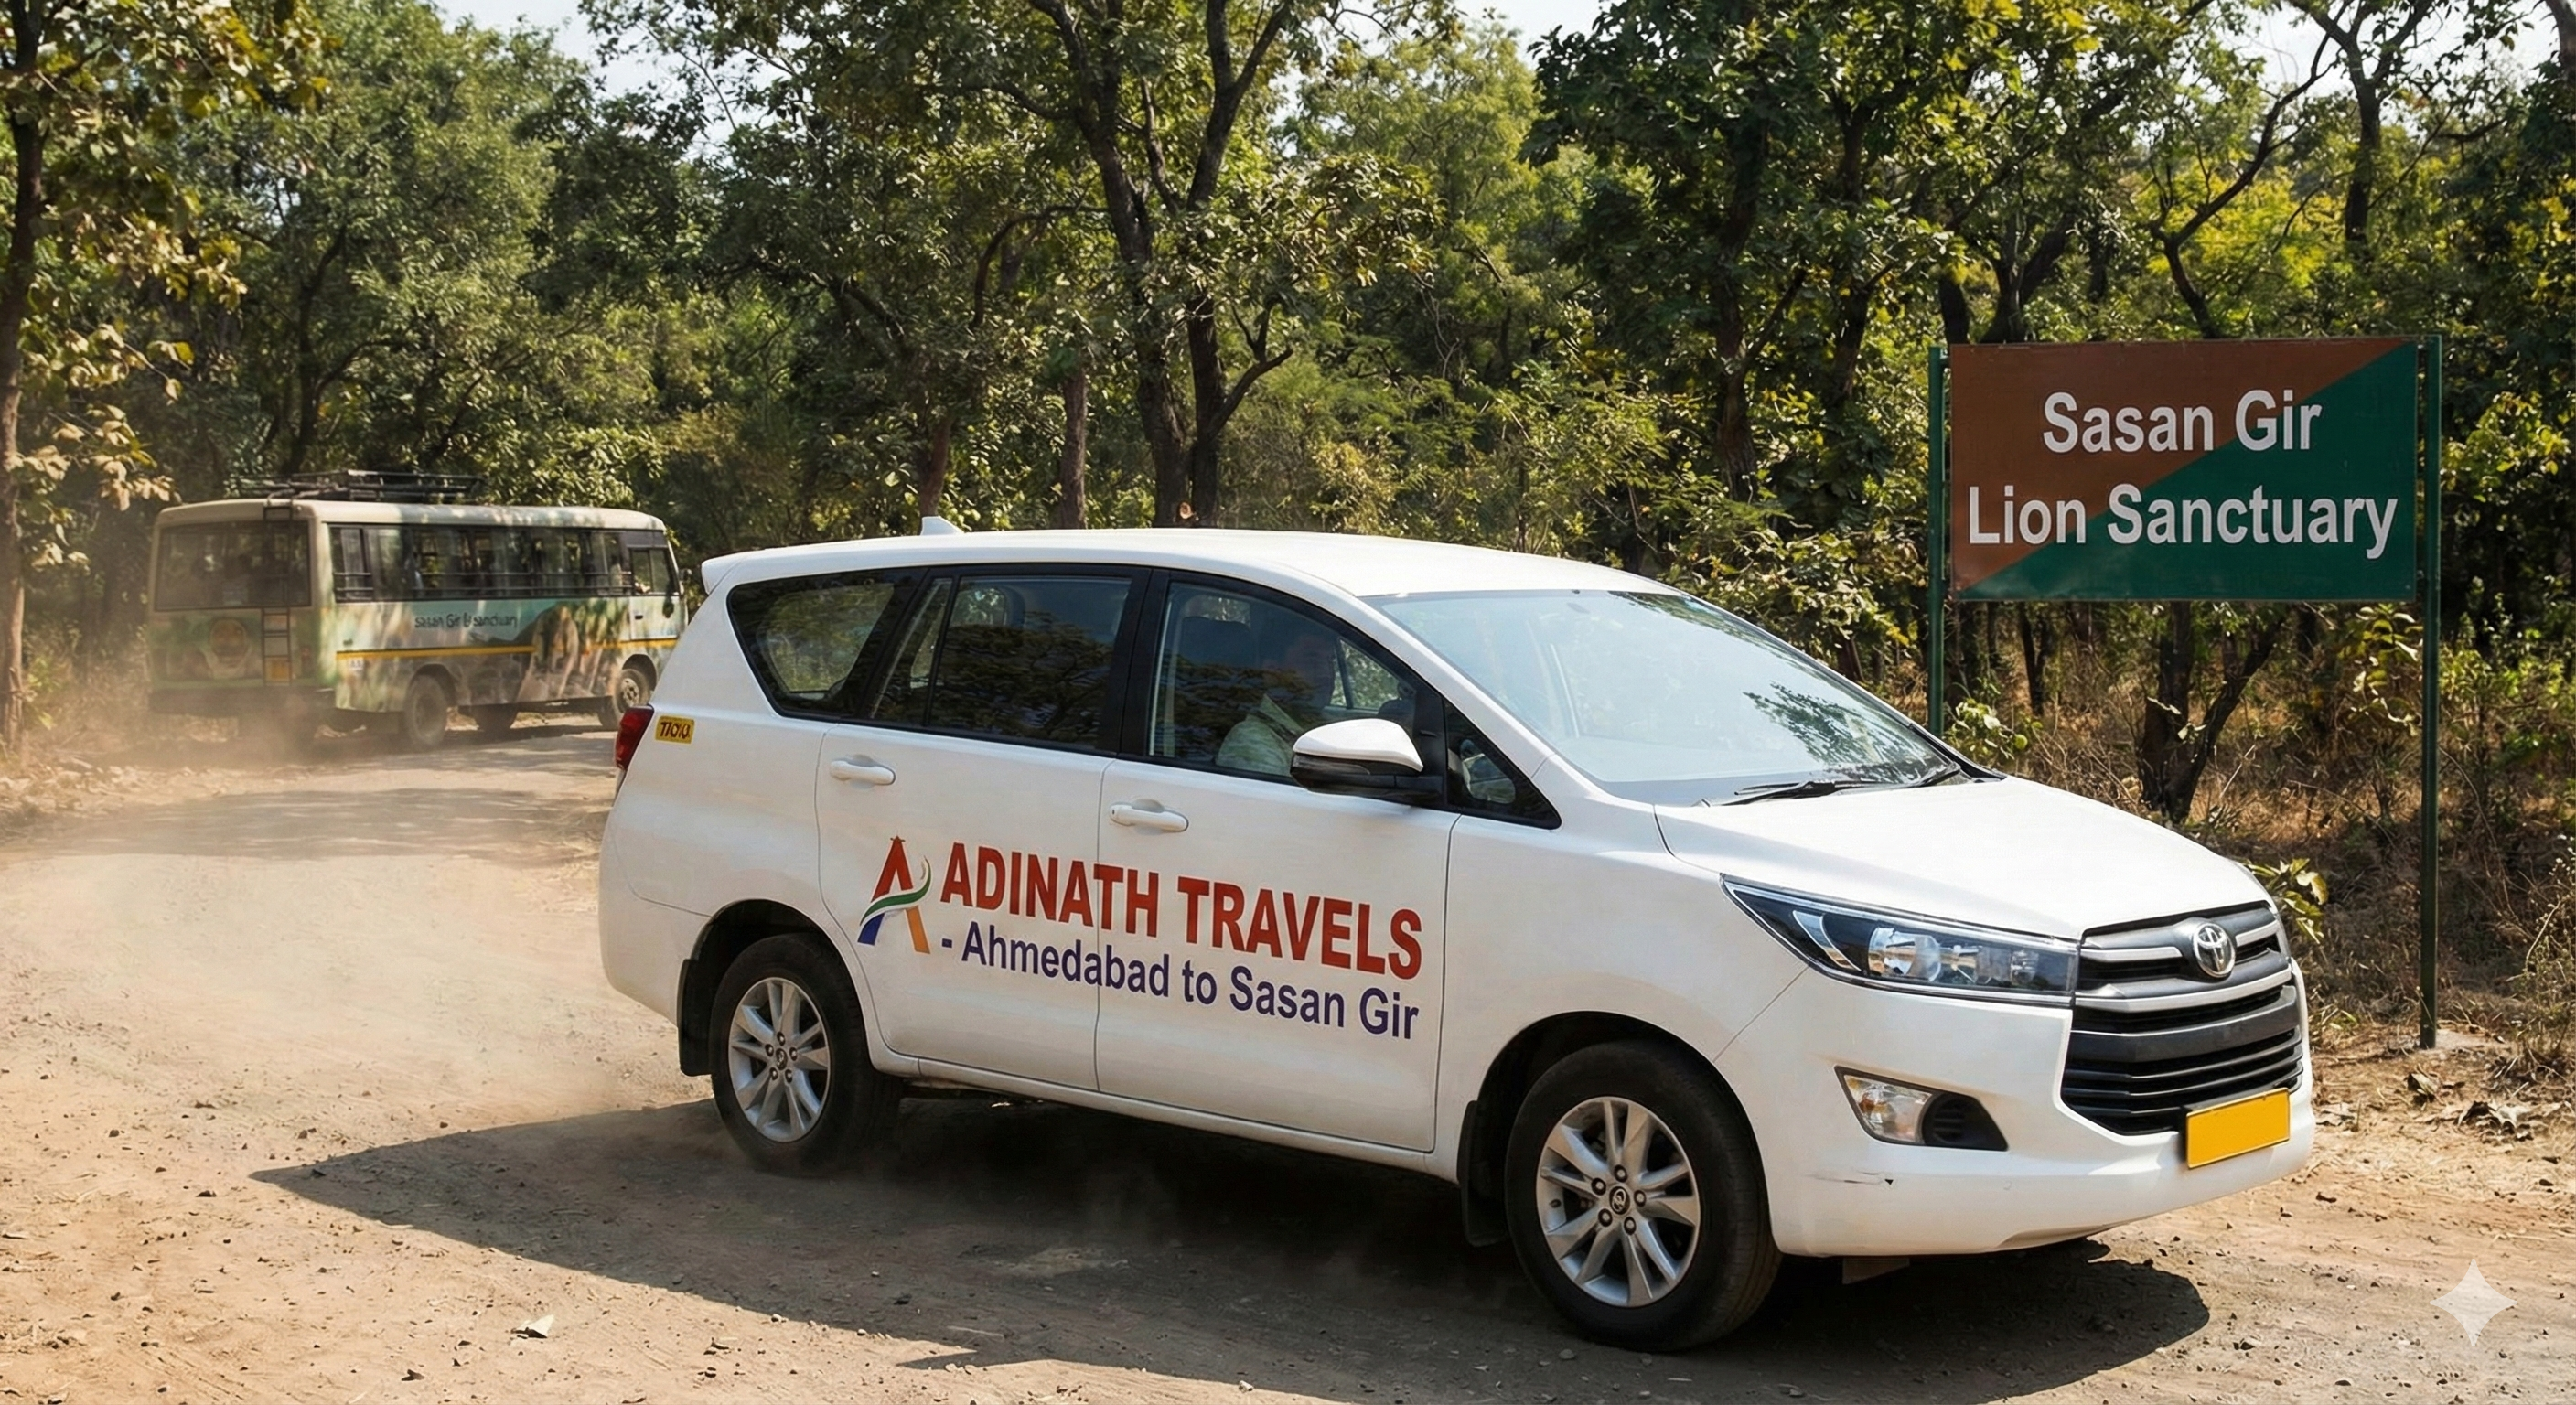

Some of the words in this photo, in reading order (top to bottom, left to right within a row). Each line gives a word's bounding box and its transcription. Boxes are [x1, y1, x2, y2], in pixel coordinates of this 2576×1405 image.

[2043, 391, 2214, 453] Sasan
[2235, 389, 2323, 451] Gir
[1969, 485, 2086, 544] Lion
[2107, 483, 2398, 559] Sanctuary
[940, 842, 1159, 938] ADINATH
[1177, 876, 1422, 980] TRAVELS
[961, 921, 1170, 998] Ahmedabad
[1181, 960, 1218, 1006] to
[1229, 965, 1346, 1028] Sasan
[1358, 986, 1420, 1039] Gir
